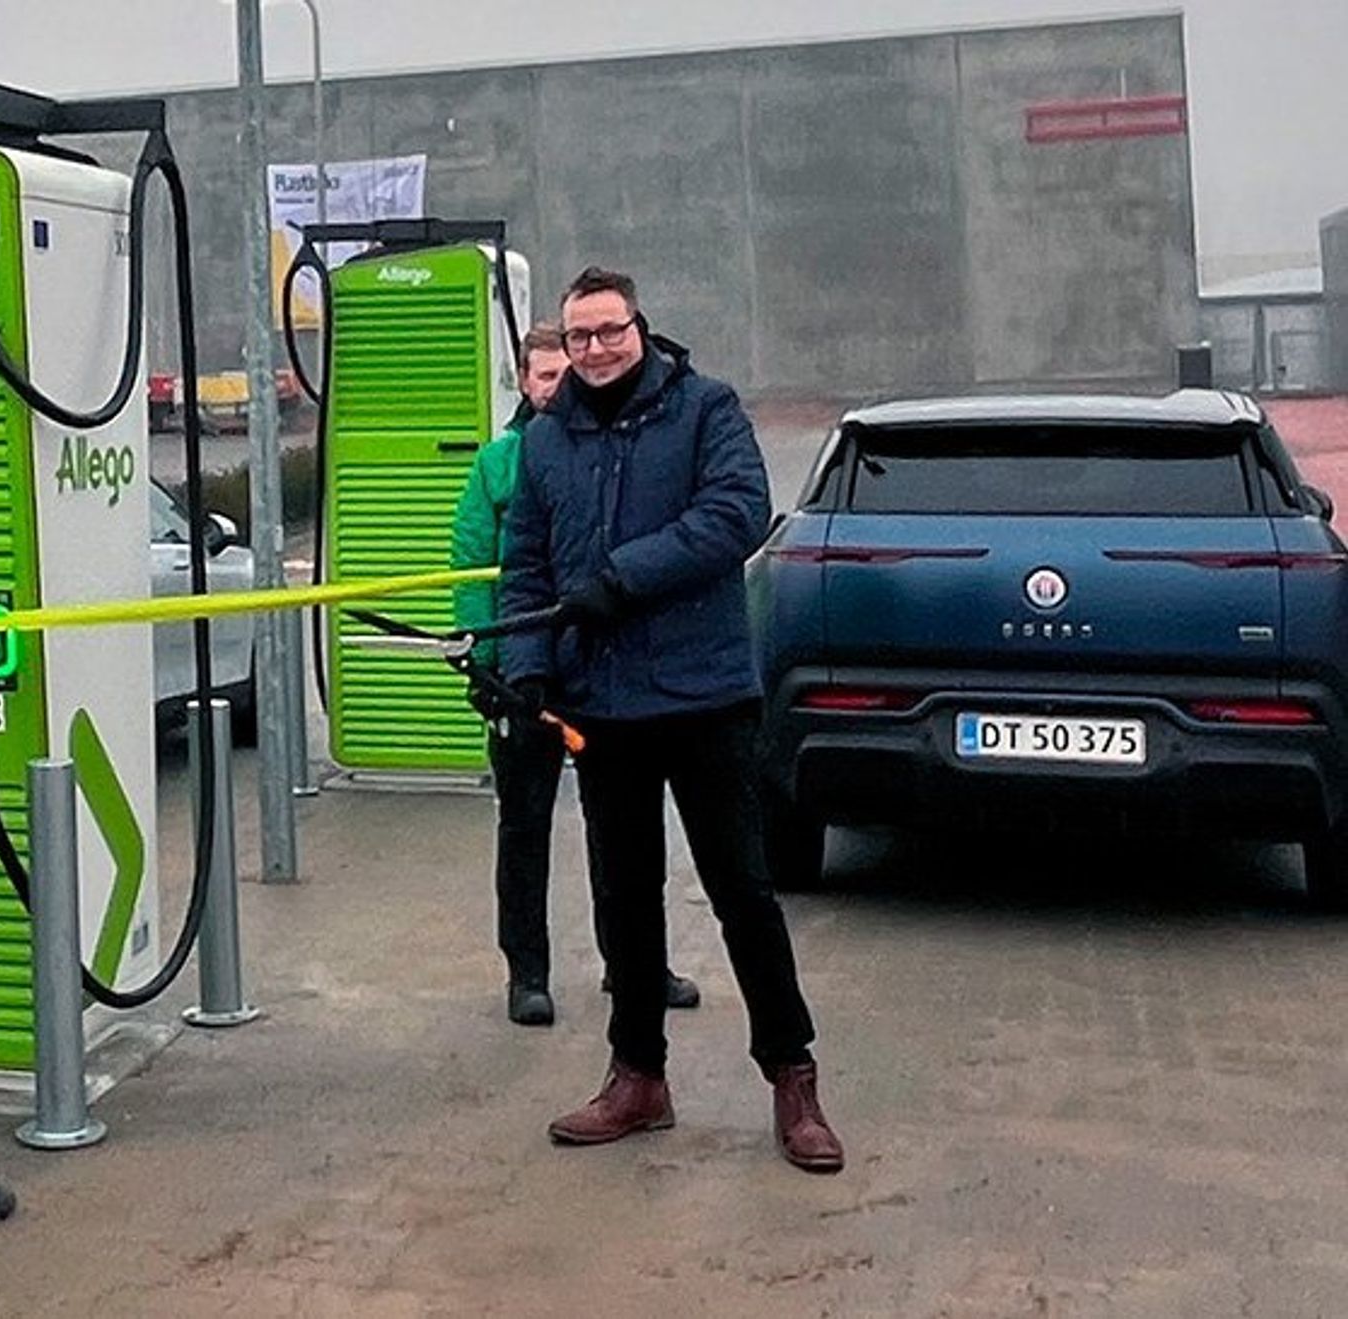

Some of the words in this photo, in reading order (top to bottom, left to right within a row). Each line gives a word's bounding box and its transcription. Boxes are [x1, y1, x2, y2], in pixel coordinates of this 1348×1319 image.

[377, 266, 432, 287] Allego
[55, 435, 134, 507] Allego
[981, 722, 1022, 749] DT
[1032, 723, 1070, 751] 50
[1079, 725, 1137, 755] 375
